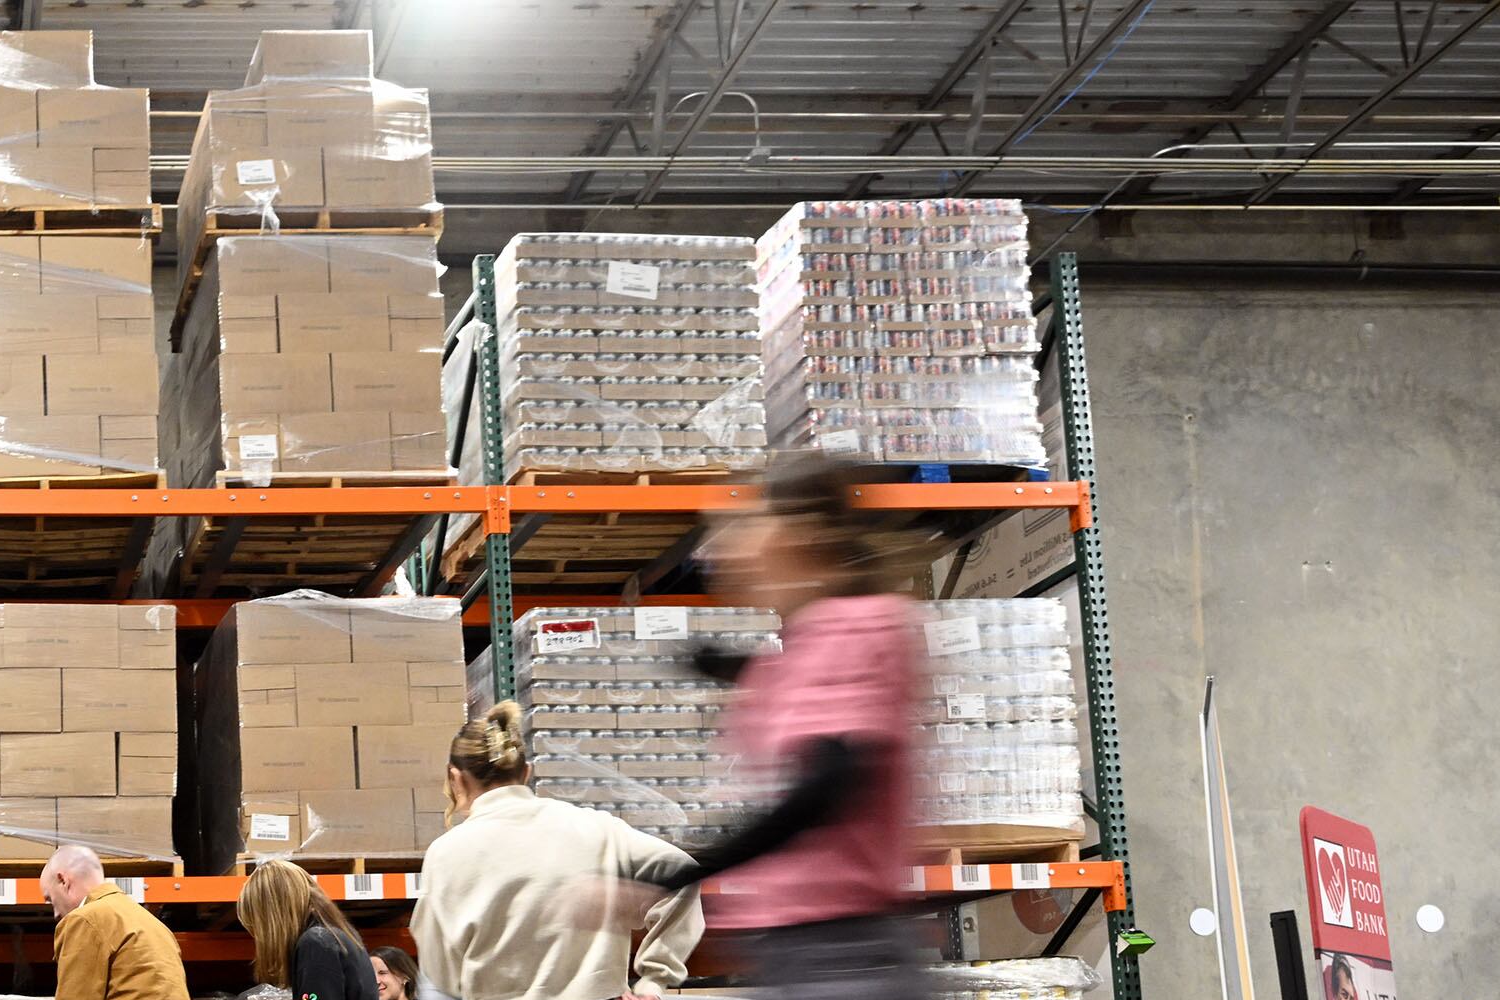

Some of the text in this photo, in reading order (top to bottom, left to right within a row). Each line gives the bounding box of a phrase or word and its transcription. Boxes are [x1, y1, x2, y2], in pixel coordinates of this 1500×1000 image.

[1346, 846, 1377, 874] UTAH
[1352, 879, 1380, 904] FOOD
[1356, 910, 1386, 936] BANK
